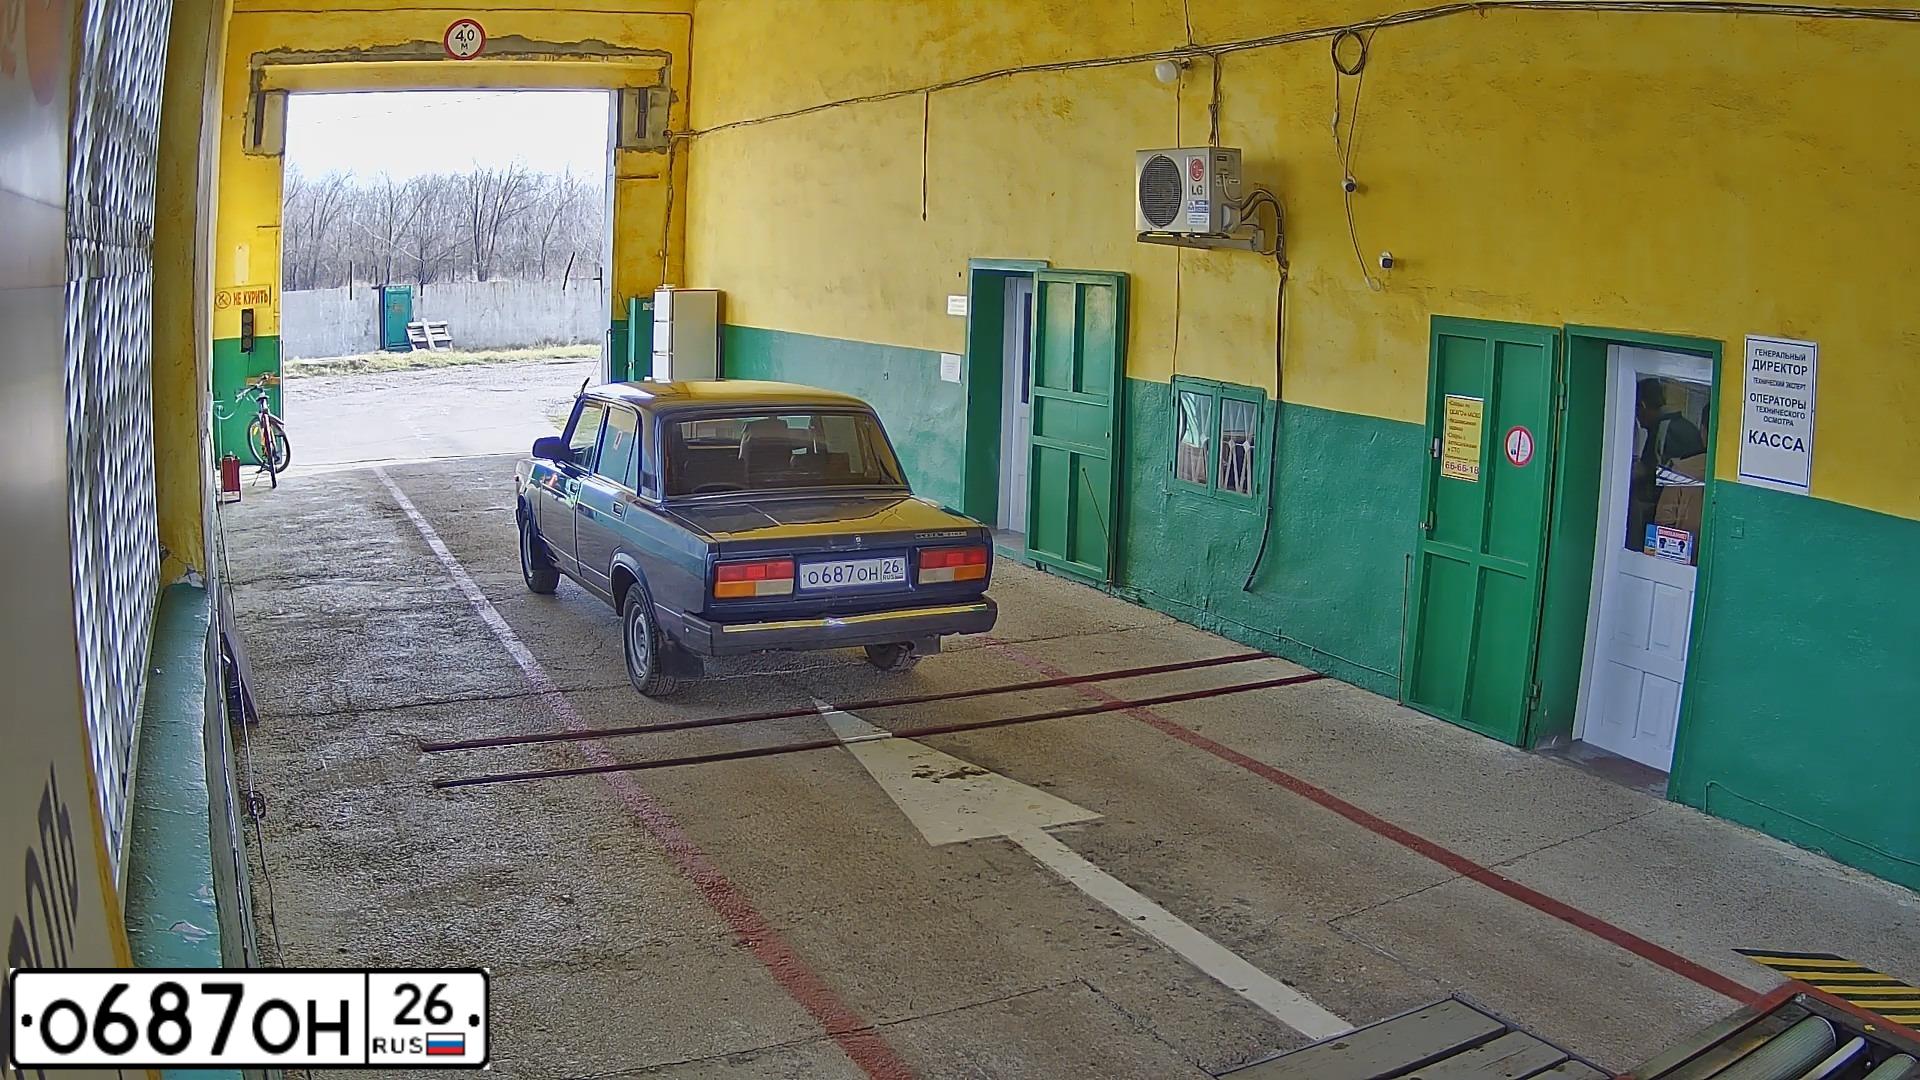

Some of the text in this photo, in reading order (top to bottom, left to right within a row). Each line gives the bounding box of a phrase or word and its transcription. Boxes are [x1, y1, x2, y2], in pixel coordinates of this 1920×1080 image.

[455, 29, 475, 42] 4,0
[1191, 185, 1203, 196] LG
[233, 290, 269, 306] НЕ КУРИТЬ
[1754, 348, 1806, 361] ГЕНЕРАЛЬНЫЙ
[1751, 359, 1808, 376] ДИРЕКТОР
[1749, 392, 1807, 410] ОПЕРАТОРЫ
[1756, 405, 1806, 419] ТЕХНИЧЕСКОГО
[1763, 415, 1794, 427] ОСМОТРА
[1748, 429, 1805, 453] КАССА
[883, 560, 900, 574] 26
